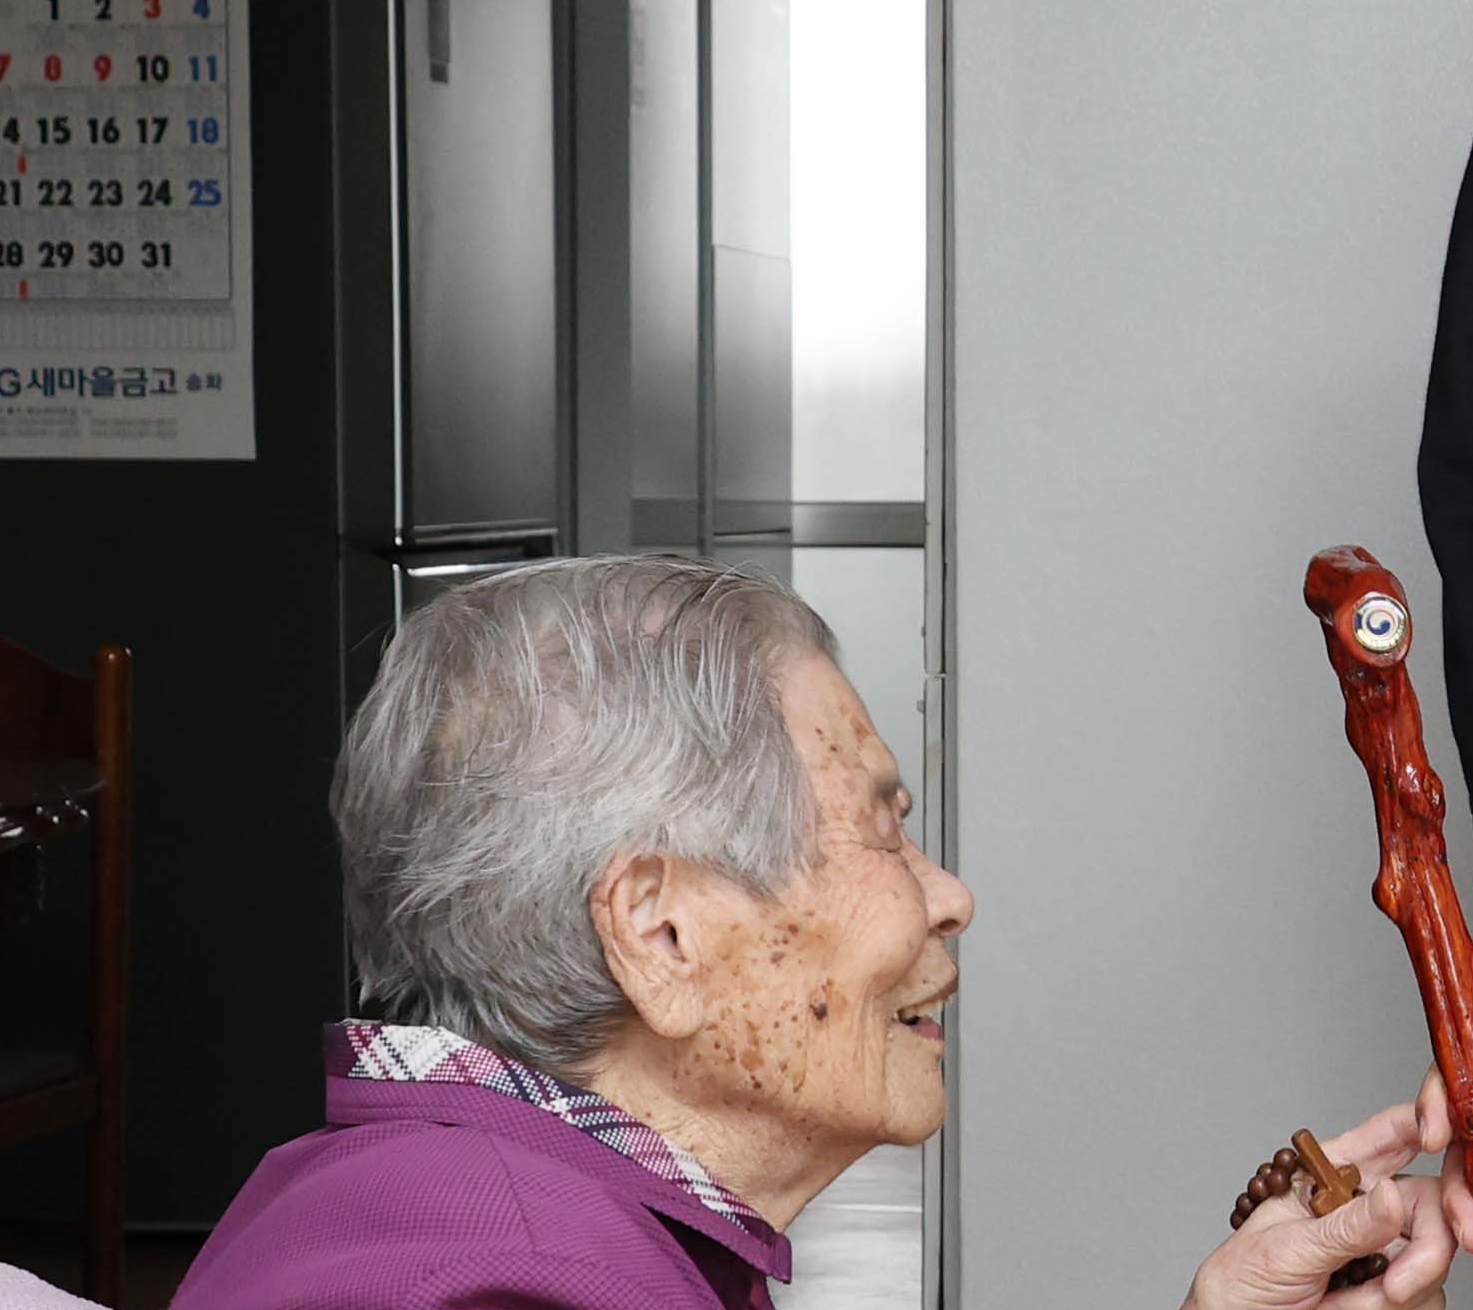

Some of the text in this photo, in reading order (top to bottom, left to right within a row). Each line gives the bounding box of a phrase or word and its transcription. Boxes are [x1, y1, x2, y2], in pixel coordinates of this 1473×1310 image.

[44, 54, 63, 82] 8
[94, 54, 113, 82] 9
[136, 54, 170, 84] 10
[189, 55, 218, 83] 11
[36, 116, 72, 146] 15
[87, 116, 121, 145] 16
[136, 116, 169, 145] 17
[188, 117, 219, 145] 18
[37, 179, 74, 207] 22
[88, 179, 124, 207] 23
[137, 178, 173, 207] 24
[188, 179, 222, 207] 25
[38, 240, 75, 268] 29
[88, 241, 124, 268] 30
[141, 241, 172, 269] 31
